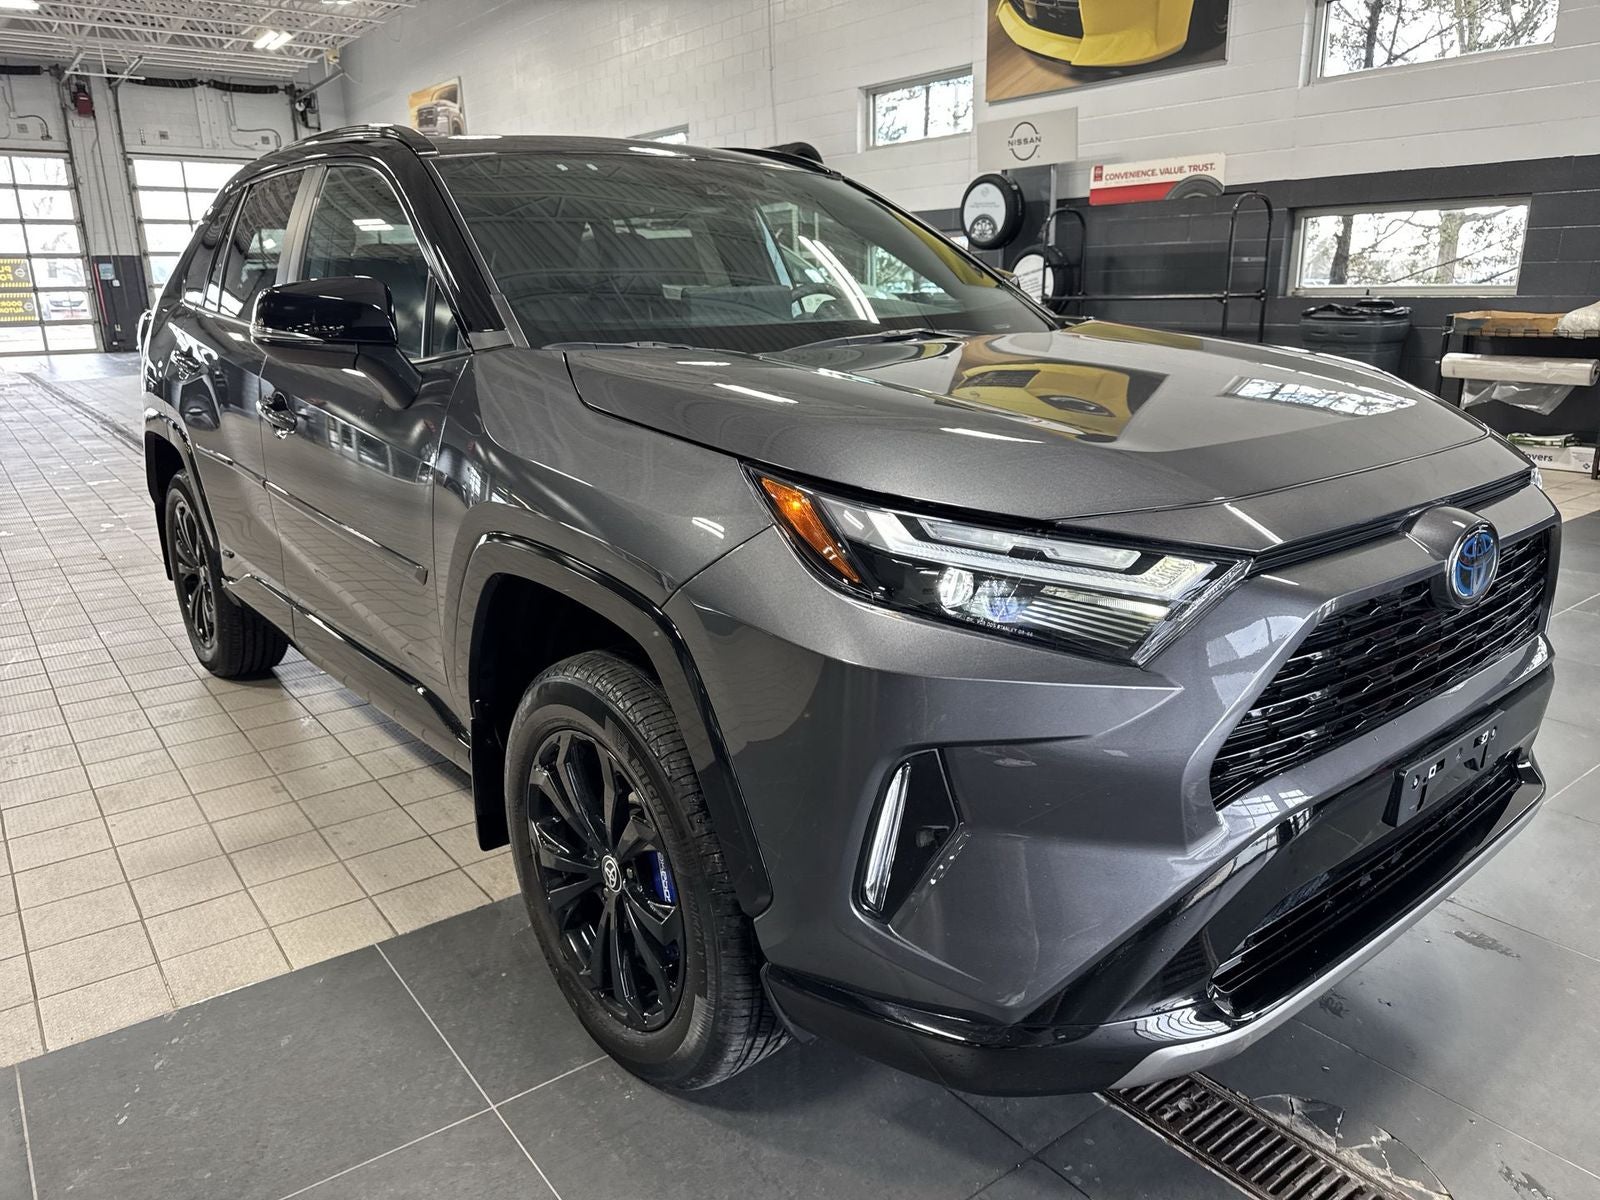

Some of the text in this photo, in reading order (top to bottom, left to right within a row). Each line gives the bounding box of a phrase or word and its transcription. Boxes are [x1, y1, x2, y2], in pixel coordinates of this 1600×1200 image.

[1008, 136, 1042, 147] NISSAN
[1104, 169, 1158, 180] CONVENIENCE.
[1160, 166, 1186, 175] VALUE.
[1188, 163, 1216, 172] TRUST.
[1523, 450, 1553, 462] overs
